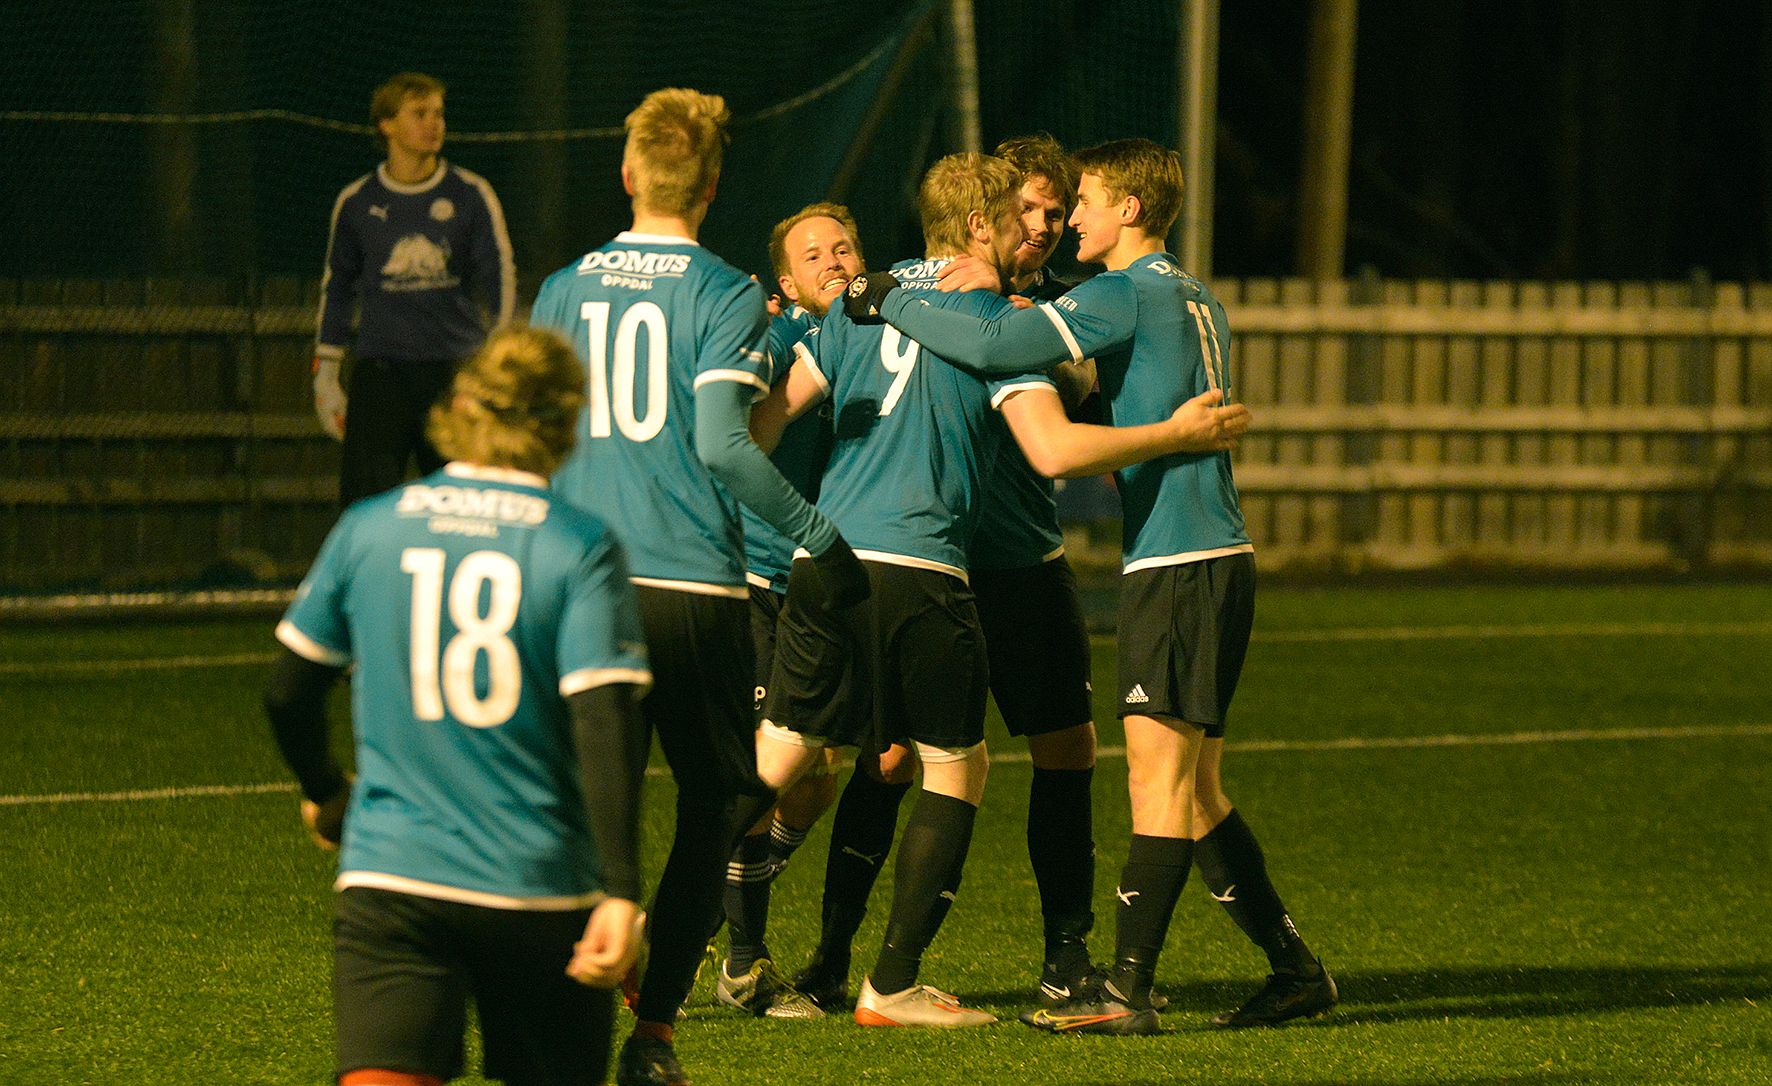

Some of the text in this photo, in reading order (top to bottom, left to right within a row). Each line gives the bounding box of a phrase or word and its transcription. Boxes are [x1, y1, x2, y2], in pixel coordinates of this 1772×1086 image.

[577, 250, 692, 274] DOMUS
[601, 273, 653, 290] OPPDAL
[888, 260, 951, 279] DOM
[581, 301, 668, 443] 10
[879, 322, 920, 416] 9
[396, 484, 549, 525] DOMUS
[400, 547, 522, 728] 18
